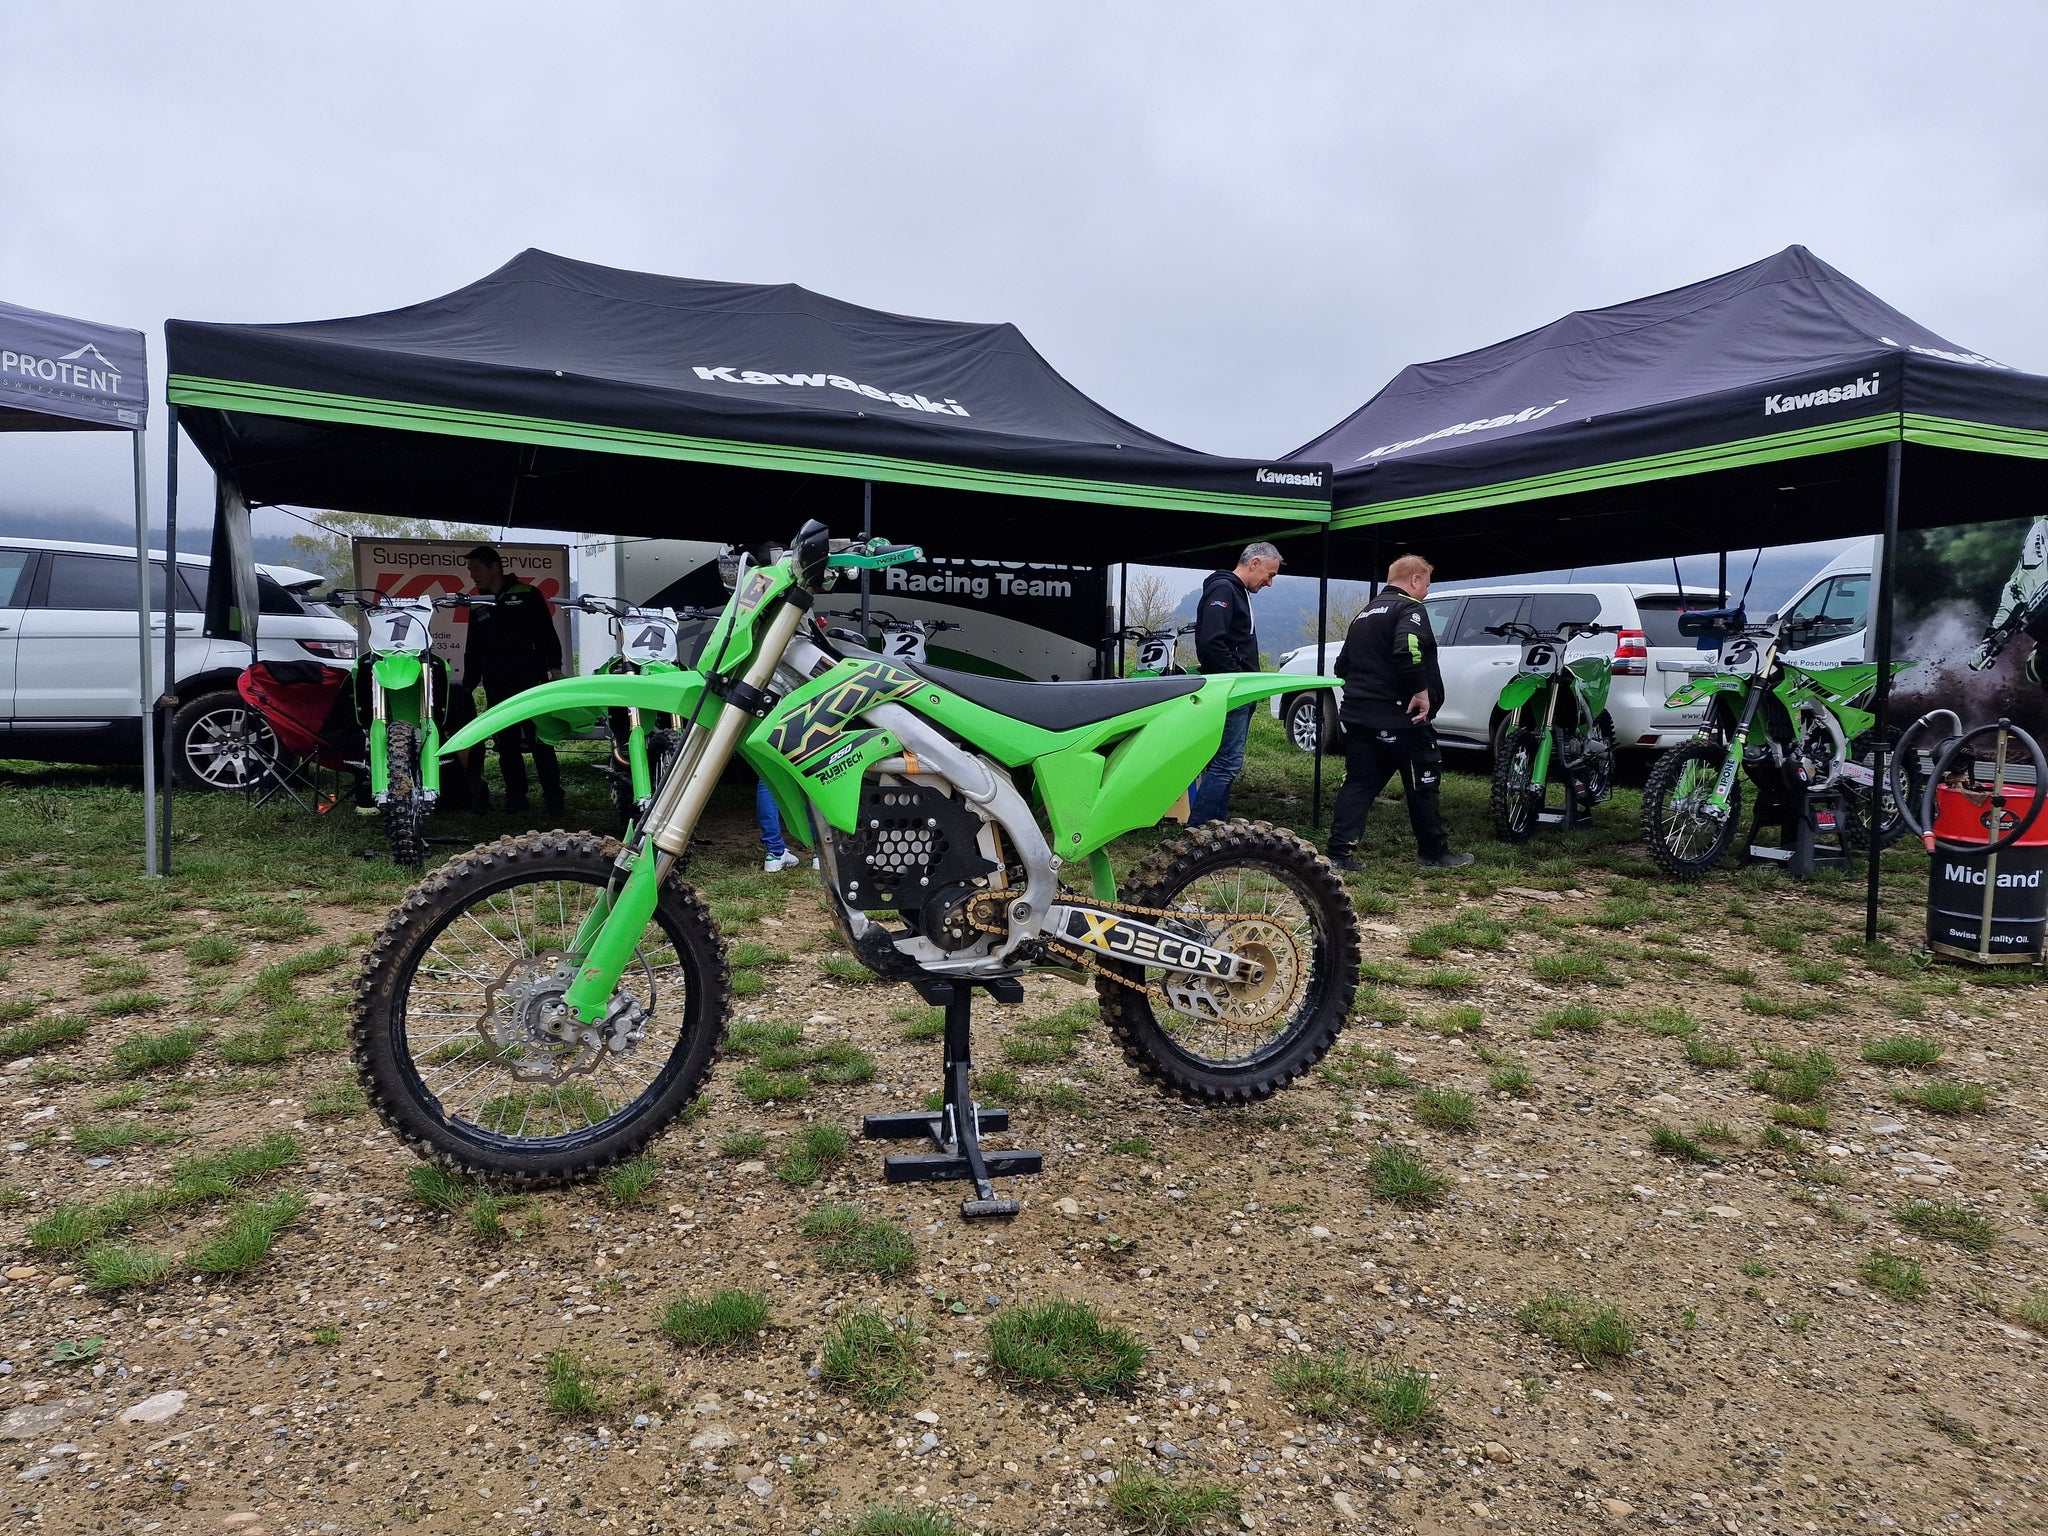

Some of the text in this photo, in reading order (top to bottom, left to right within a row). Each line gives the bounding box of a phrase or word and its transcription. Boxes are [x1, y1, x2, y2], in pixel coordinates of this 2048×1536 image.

[2, 350, 122, 394] PROTENT
[3, 379, 119, 407] SWITZERLAND
[691, 366, 971, 417] Kawasaki
[1765, 371, 1880, 416] Kawasaki
[1355, 398, 1569, 462] Kawasaki
[1256, 468, 1323, 487] Kawasaki
[373, 547, 553, 569] Suspensio ervice
[874, 553, 905, 564] TWENTY
[886, 568, 1072, 599] Racing Team
[385, 615, 413, 642] 1
[631, 625, 667, 652] 4
[893, 634, 919, 656] 2
[1140, 643, 1164, 664] 5
[1525, 647, 1554, 667] 6
[1723, 641, 1758, 666] 3
[1800, 659, 1840, 668] Poschung
[772, 663, 918, 758] KX
[828, 743, 852, 764] 250
[815, 751, 863, 785] RUBITECH
[1719, 759, 1736, 787] IPONE
[1945, 863, 2040, 888] Midand
[1079, 912, 1222, 975] XDECOR
[1949, 928, 2030, 944] Swiss uality Oil.
